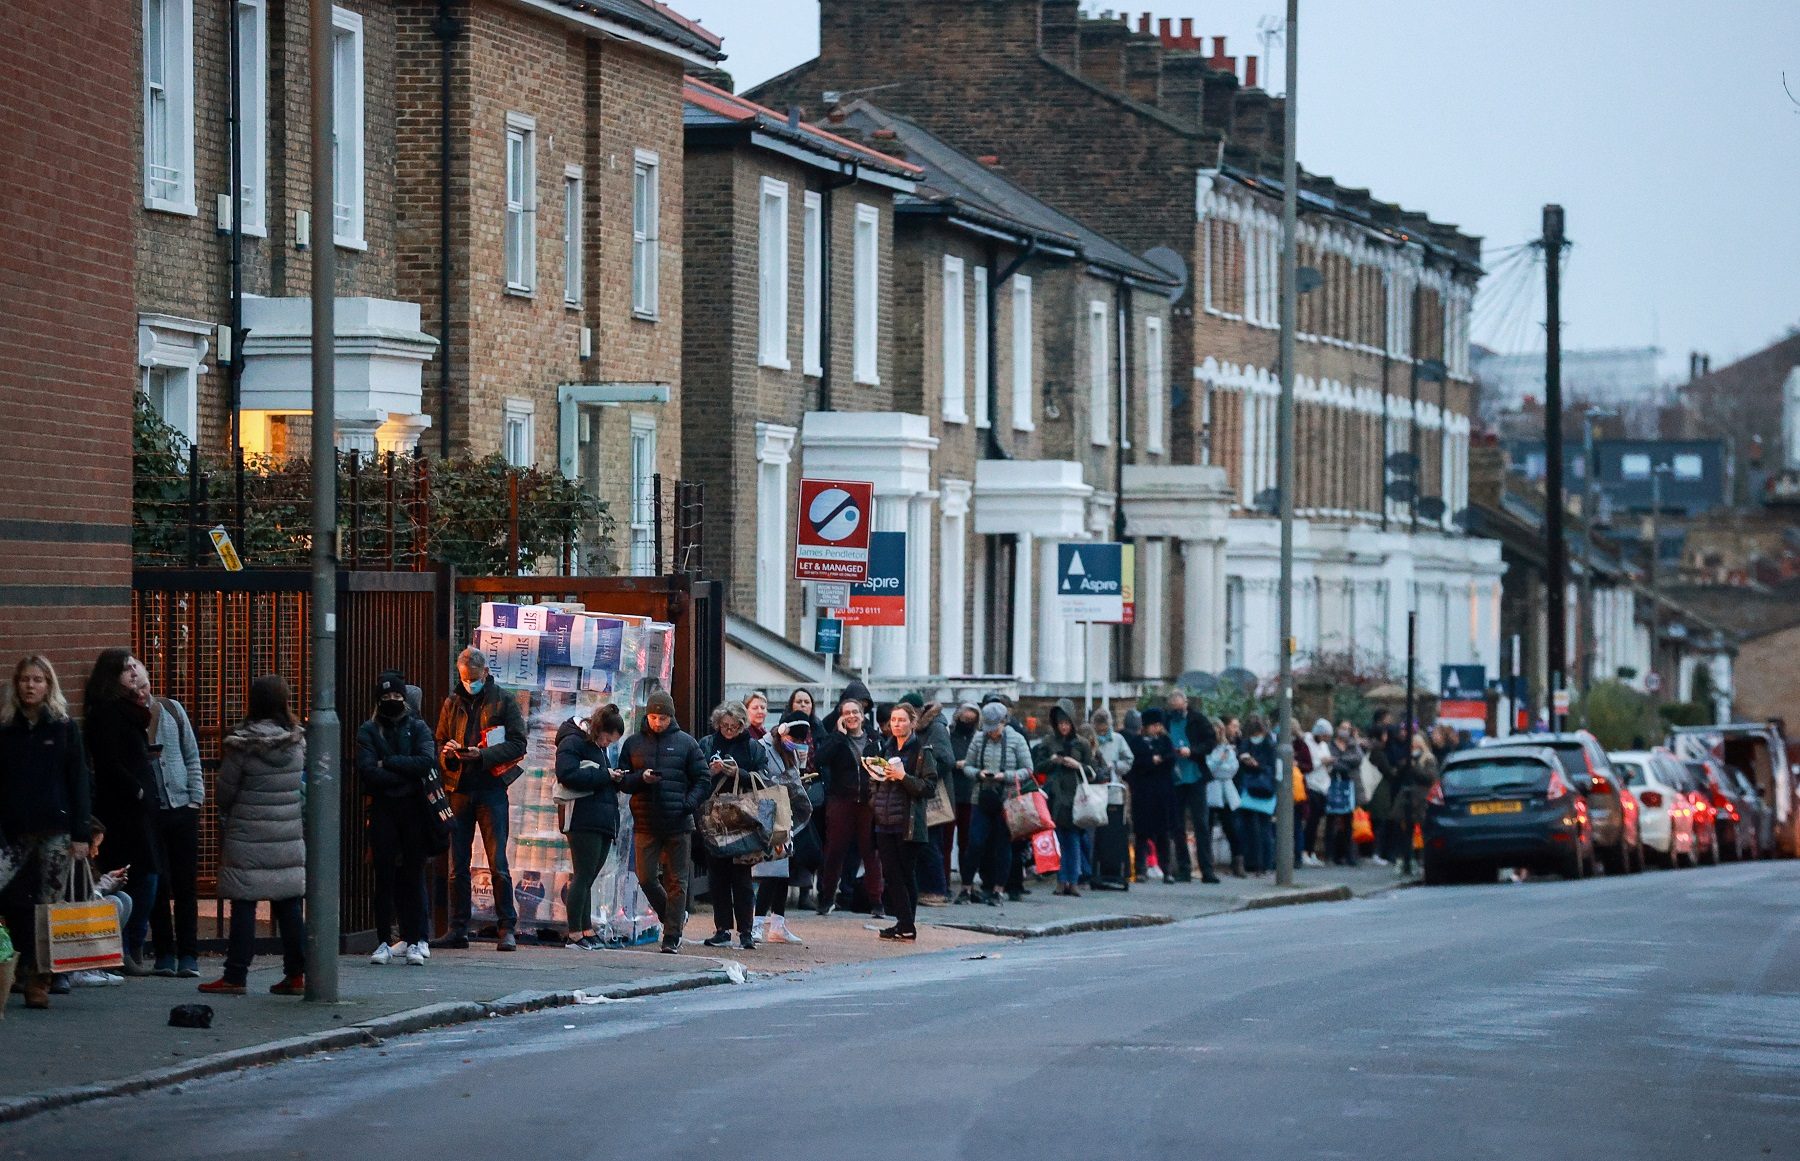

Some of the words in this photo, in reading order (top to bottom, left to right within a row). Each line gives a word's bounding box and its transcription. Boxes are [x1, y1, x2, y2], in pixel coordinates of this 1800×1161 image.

[798, 547, 823, 557] James
[825, 549, 866, 559] Pendleton
[799, 562, 813, 570] LET
[822, 563, 863, 573] MANAGED
[515, 637, 533, 683] Tyrrells
